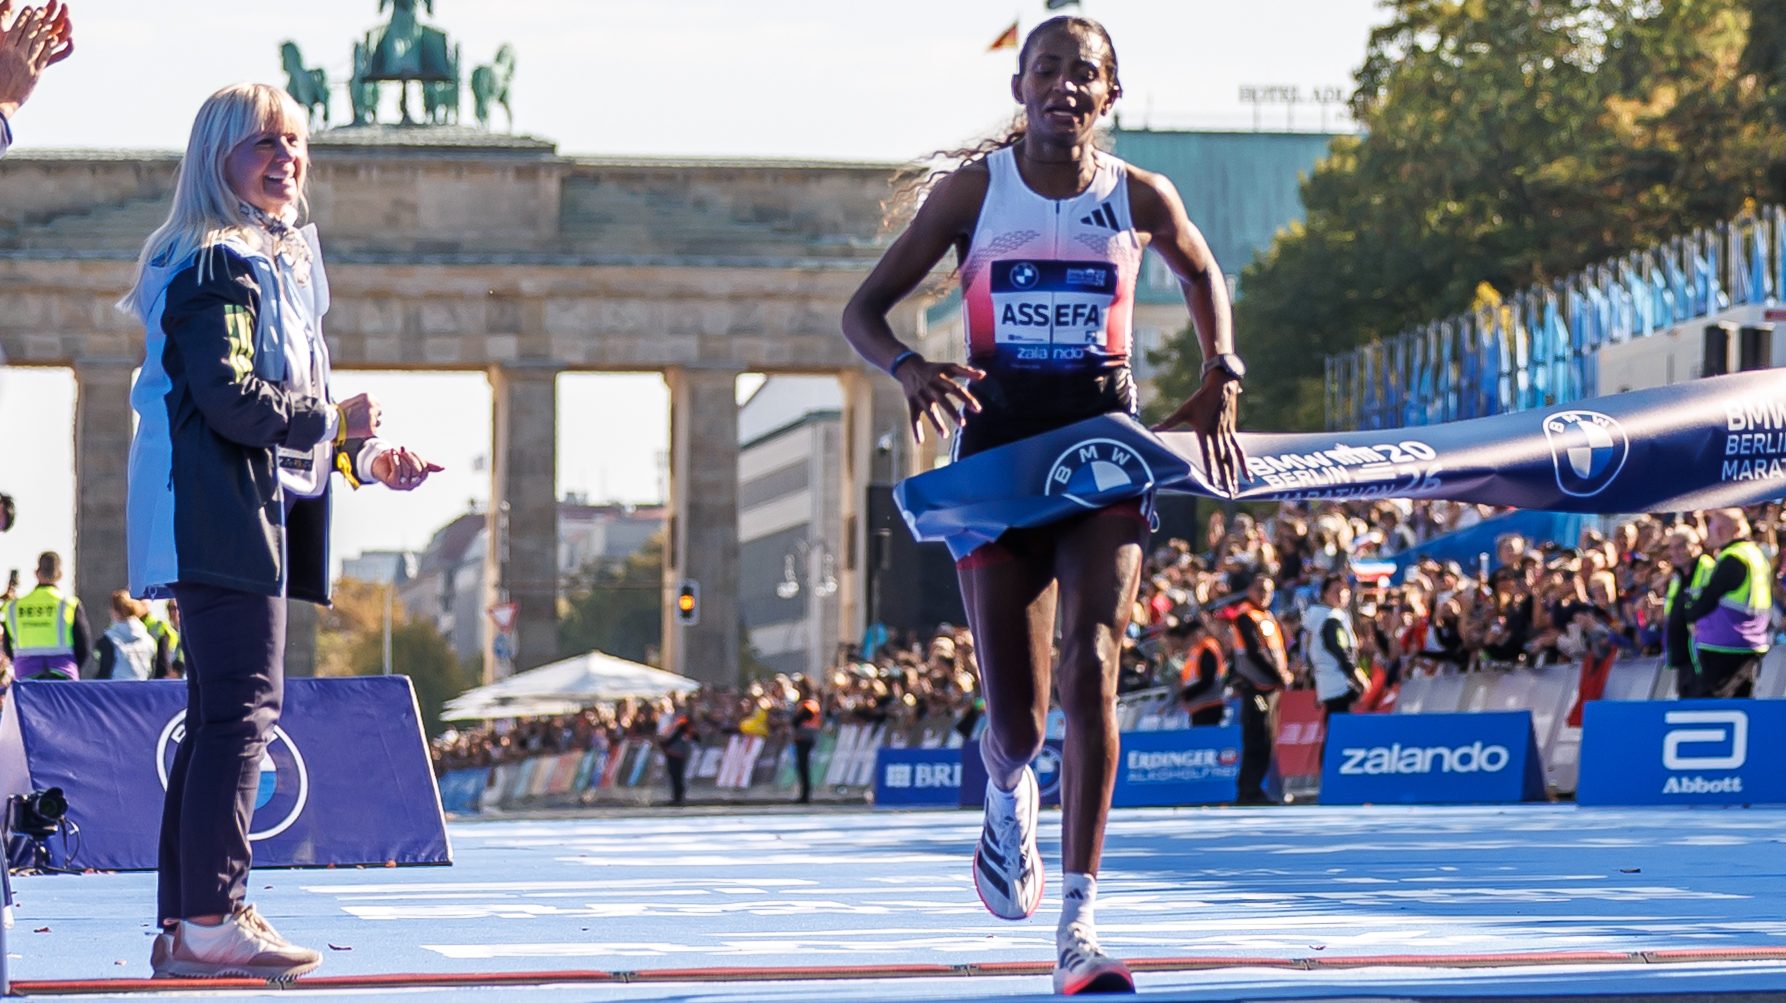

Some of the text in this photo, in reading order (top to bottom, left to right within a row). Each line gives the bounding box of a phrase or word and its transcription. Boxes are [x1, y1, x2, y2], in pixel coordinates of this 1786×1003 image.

[1001, 303, 1100, 327] ASSEFA
[1017, 344, 1085, 359] zalando
[1548, 411, 1611, 434] BMW
[1725, 400, 1786, 431] BMW
[1725, 431, 1786, 455] BERLI
[1053, 444, 1132, 485] BMW
[1249, 440, 1437, 480] BMW 20
[1262, 464, 1353, 489] BERLIN
[18, 606, 54, 618] BEST
[1127, 749, 1218, 769] ERDINGER
[1339, 740, 1510, 775] zalando
[1661, 775, 1743, 794] Abbott
